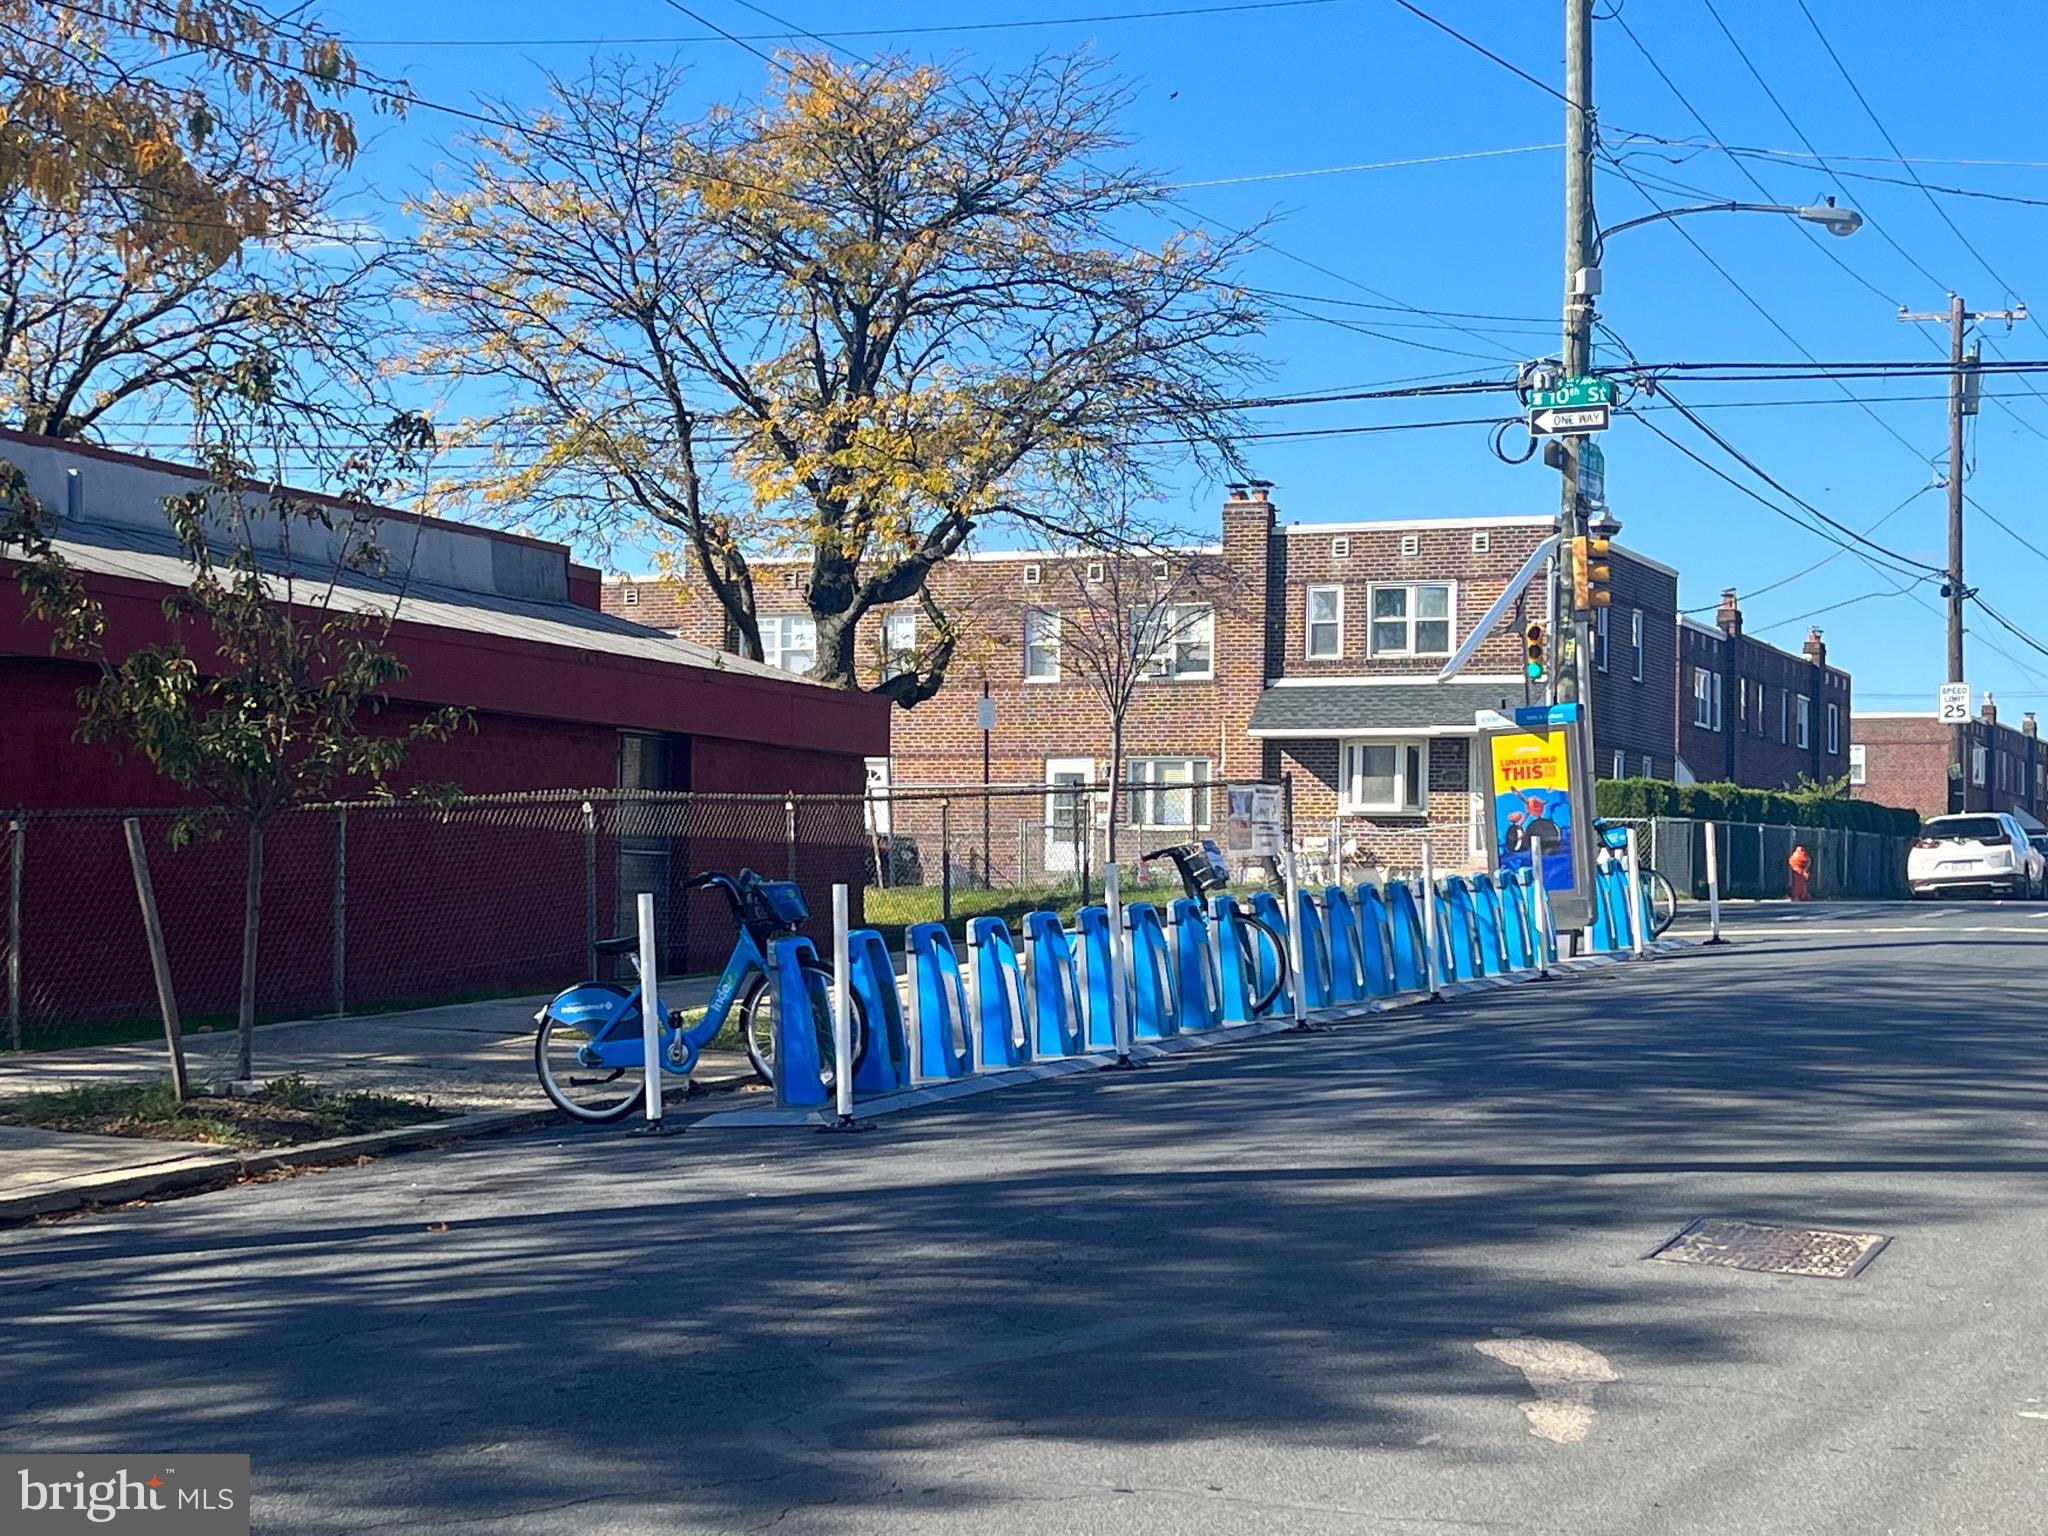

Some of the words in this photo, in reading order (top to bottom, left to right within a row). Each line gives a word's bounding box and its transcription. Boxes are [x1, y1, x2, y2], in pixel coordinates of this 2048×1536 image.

[1548, 387, 1580, 405] 10th
[1588, 386, 1607, 402] St
[1553, 415, 1575, 426] ONE
[1578, 413, 1601, 424] WAY
[1942, 687, 1968, 695] SPEED
[1944, 695, 1966, 703] LIMIT
[1944, 704, 1967, 718] 25
[1502, 765, 1543, 781] THIS
